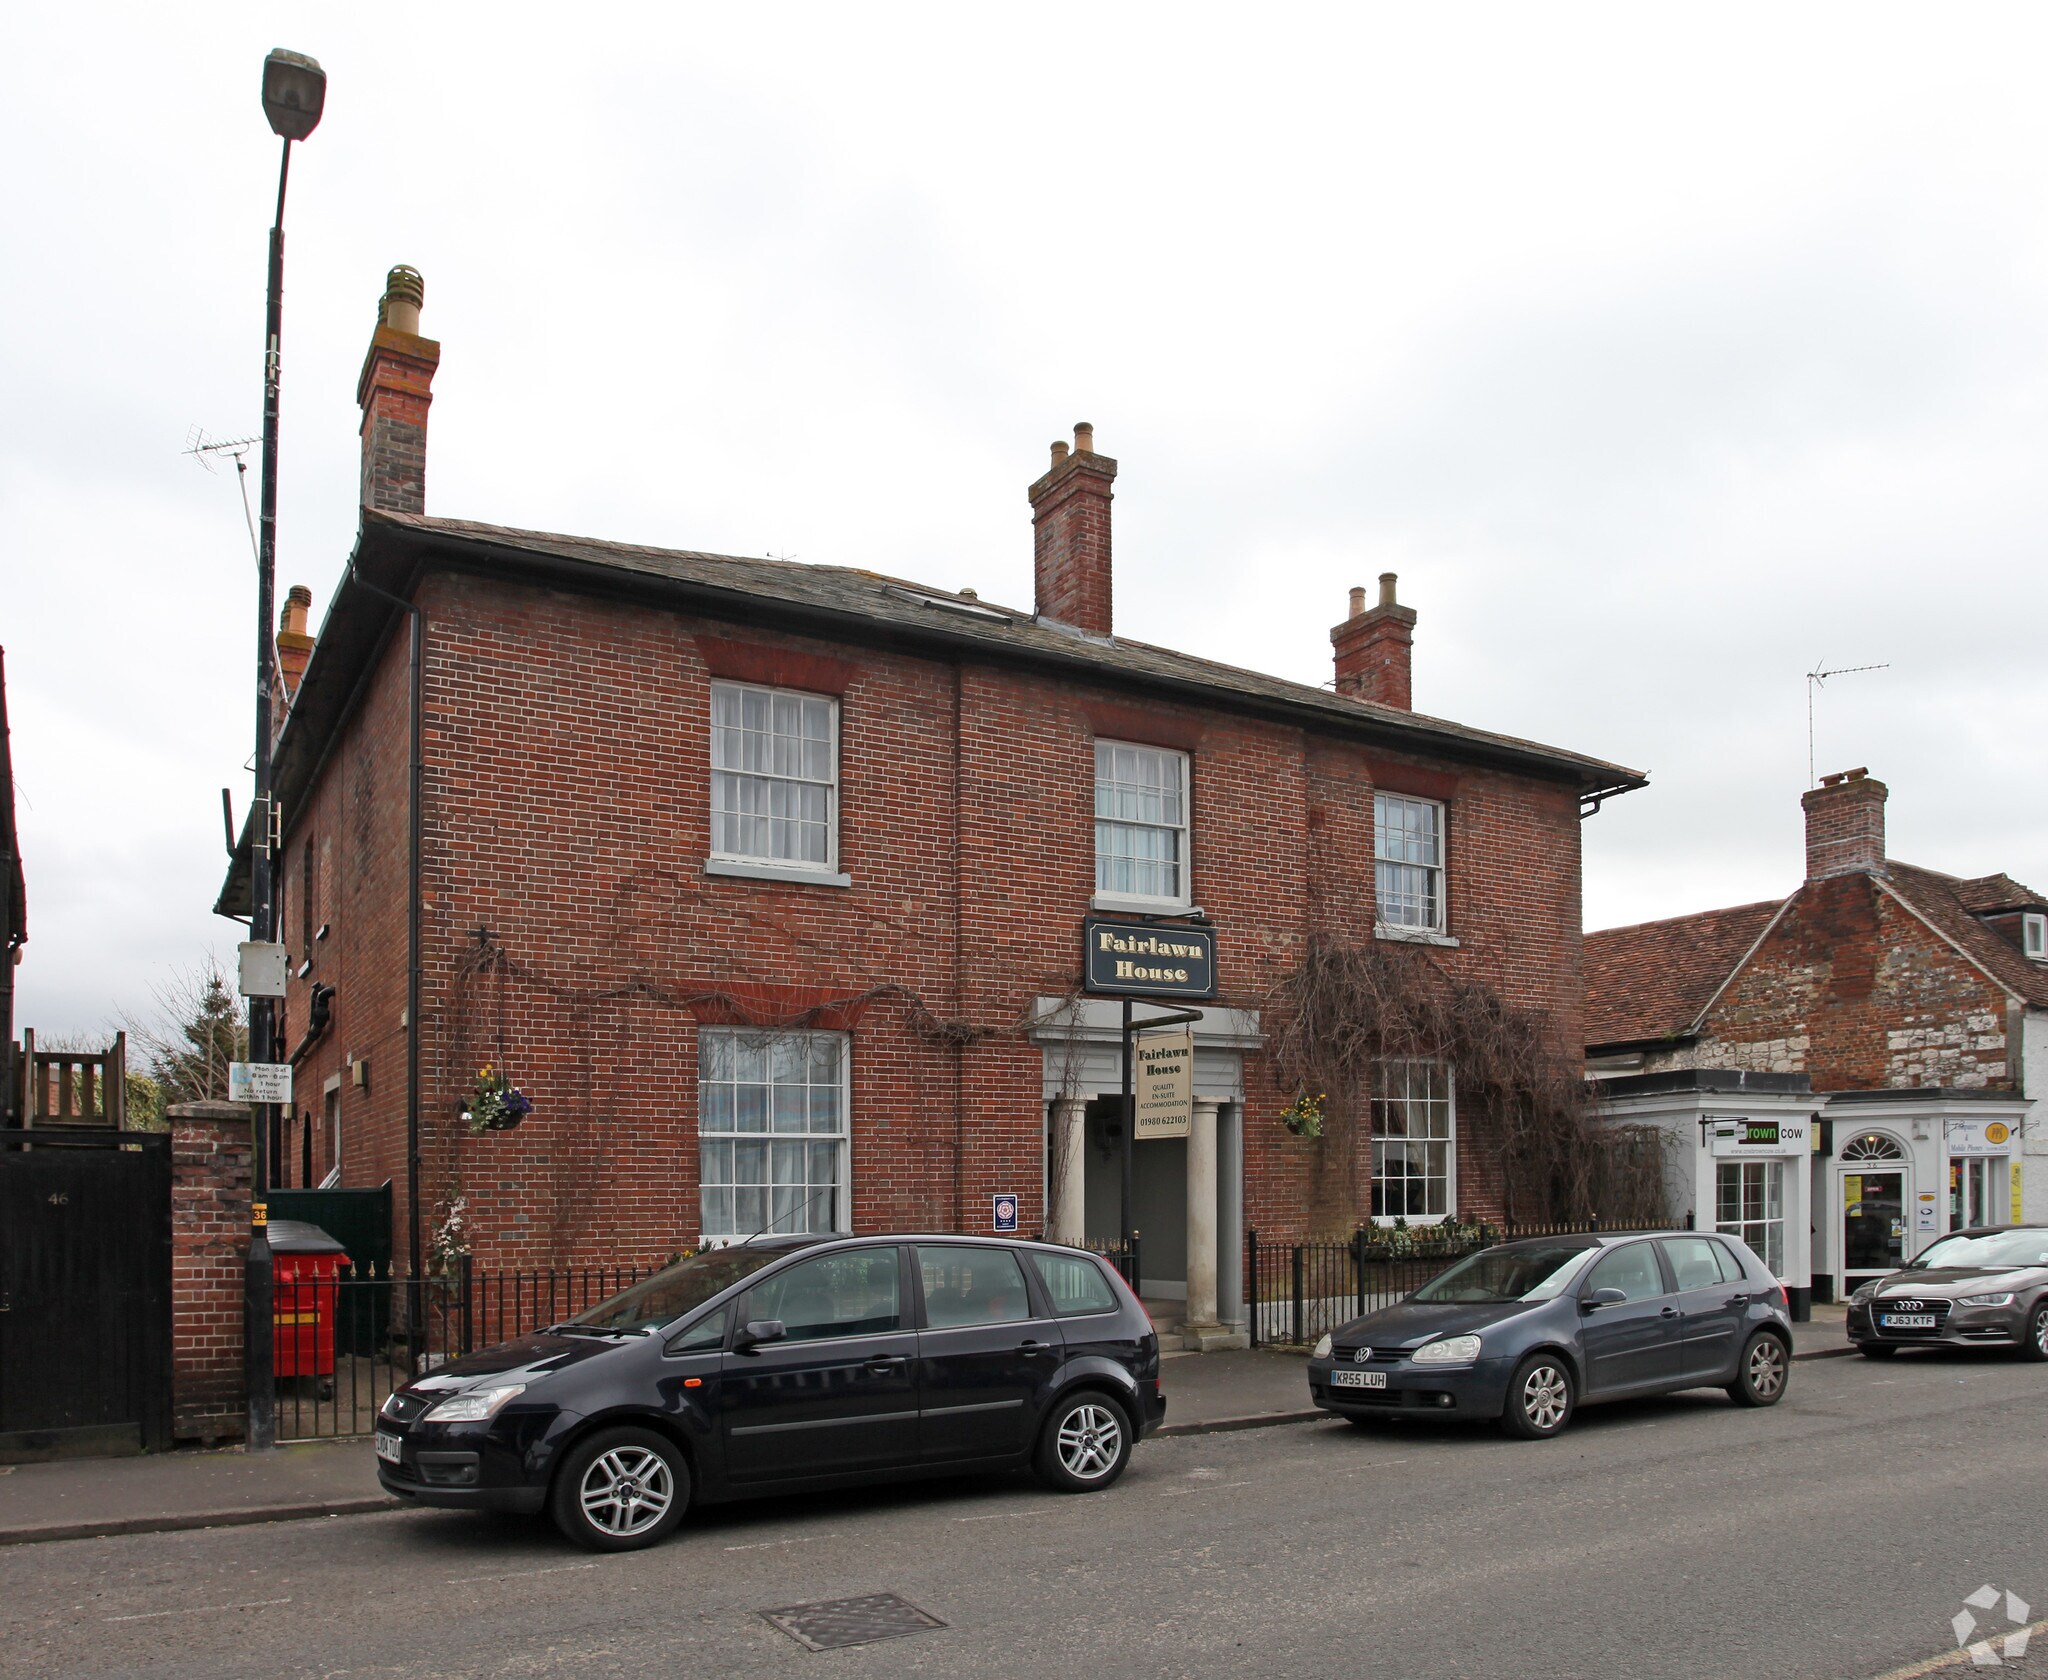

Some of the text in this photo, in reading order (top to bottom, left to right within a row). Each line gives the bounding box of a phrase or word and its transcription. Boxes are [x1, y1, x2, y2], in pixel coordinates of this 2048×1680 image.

[1099, 932, 1203, 959] Fairlawn
[1115, 960, 1188, 983] House
[1138, 1048, 1189, 1061] Fairlawn
[1146, 1065, 1181, 1076] House
[1152, 1083, 1175, 1092] QUALITY
[1152, 1092, 1175, 1100] EN-SUITE
[1140, 1100, 1188, 1109] ACCOMMODATION
[1140, 1115, 1187, 1126] 01980 622103
[1746, 1127, 1776, 1139] rown
[48, 1192, 69, 1205] 46
[254, 1211, 267, 1219] 36
[1886, 1316, 1933, 1325] RJ63 KTF
[1337, 1372, 1385, 1387] KR55 LUH
